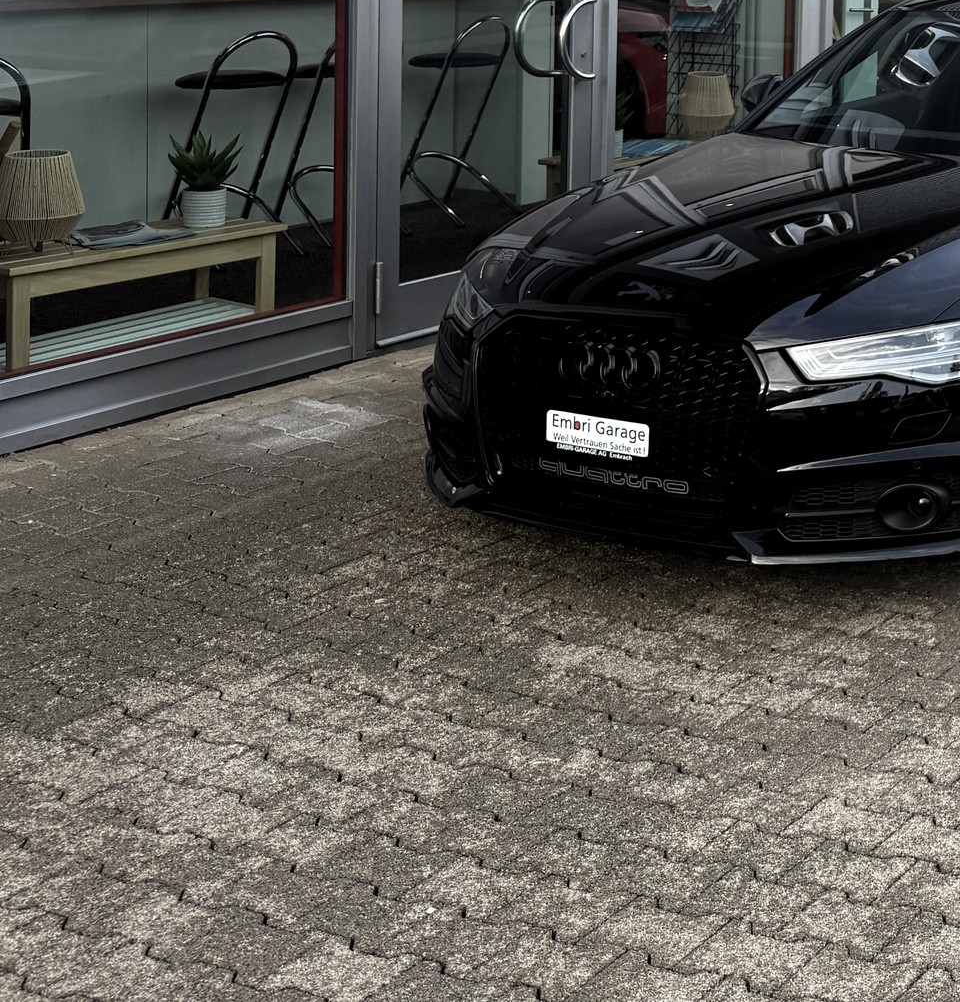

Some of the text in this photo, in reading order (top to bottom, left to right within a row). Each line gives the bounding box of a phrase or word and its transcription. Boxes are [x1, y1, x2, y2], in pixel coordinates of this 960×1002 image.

[552, 413, 646, 444] Embri Garage
[553, 432, 569, 442] Weil
[571, 435, 607, 449] Vertrauen
[609, 441, 632, 453] Sache
[609, 452, 633, 461] Embrach
[538, 457, 690, 495] quattro
